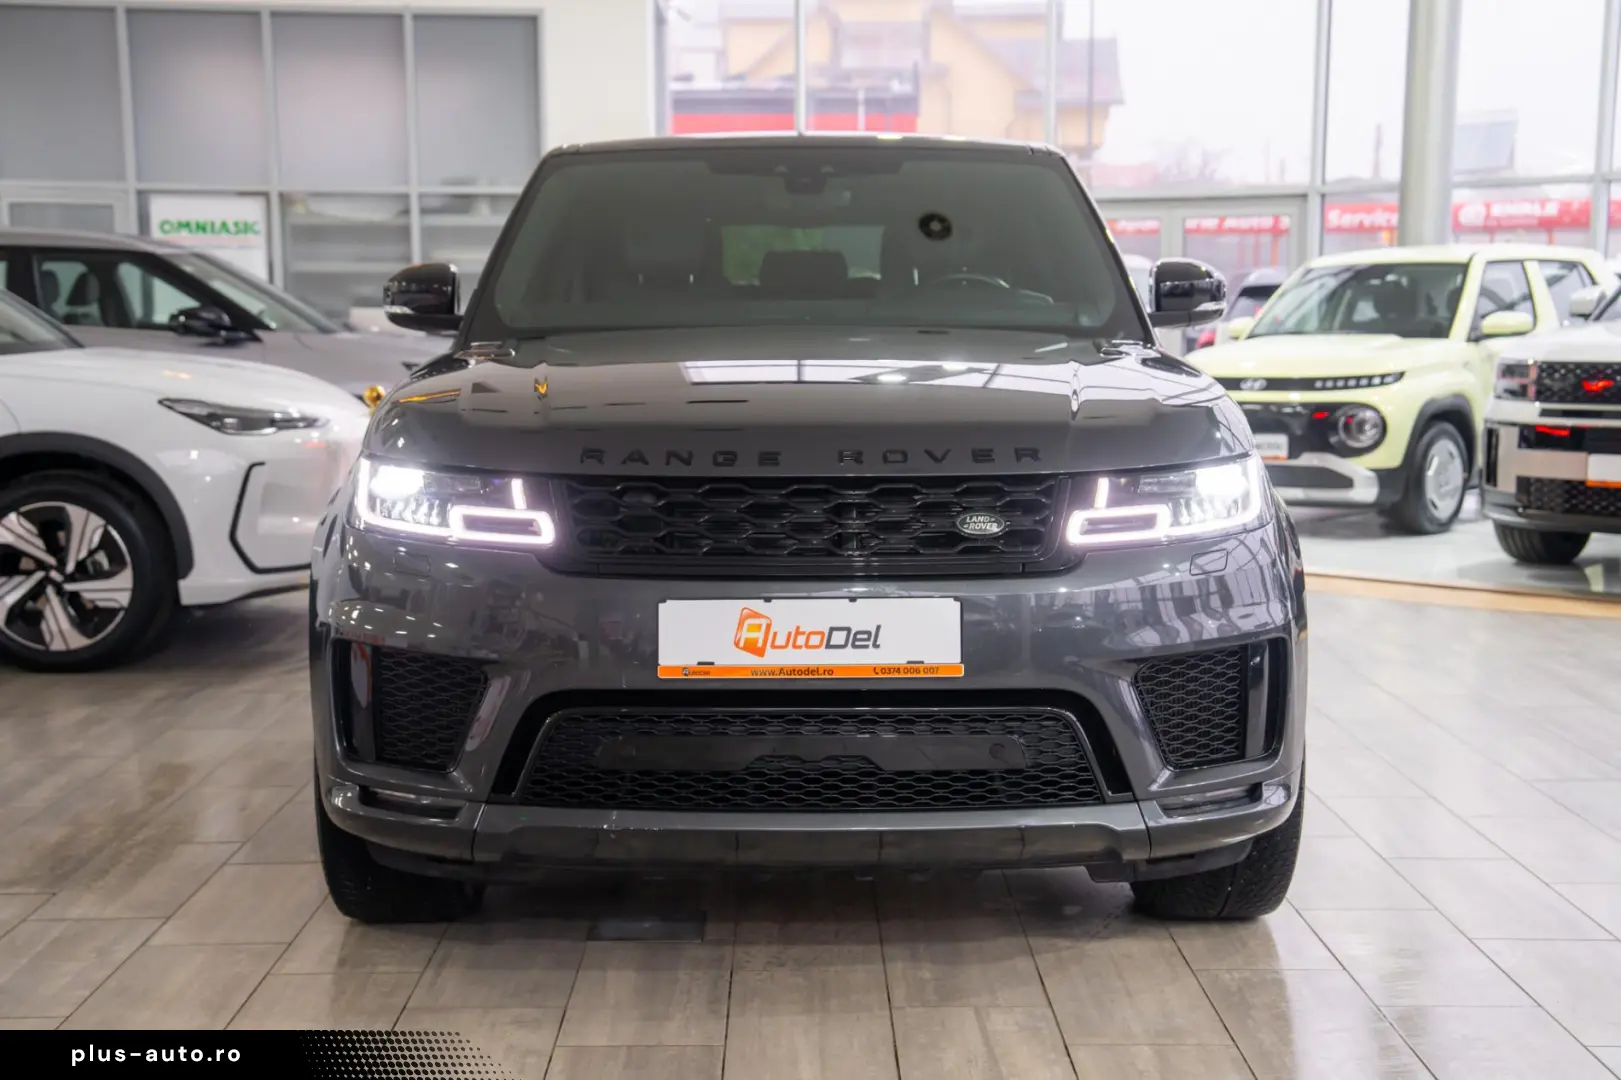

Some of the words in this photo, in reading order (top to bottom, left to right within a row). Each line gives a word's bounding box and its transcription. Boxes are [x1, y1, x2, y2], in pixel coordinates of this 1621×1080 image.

[580, 447, 781, 467] RANGE
[837, 447, 1041, 465] ROVER
[966, 515, 990, 523] LAND
[968, 522, 998, 531] ROVER
[734, 606, 881, 658] AutoDel
[751, 667, 834, 677] www.Autodel.ro
[880, 667, 901, 675] 0374
